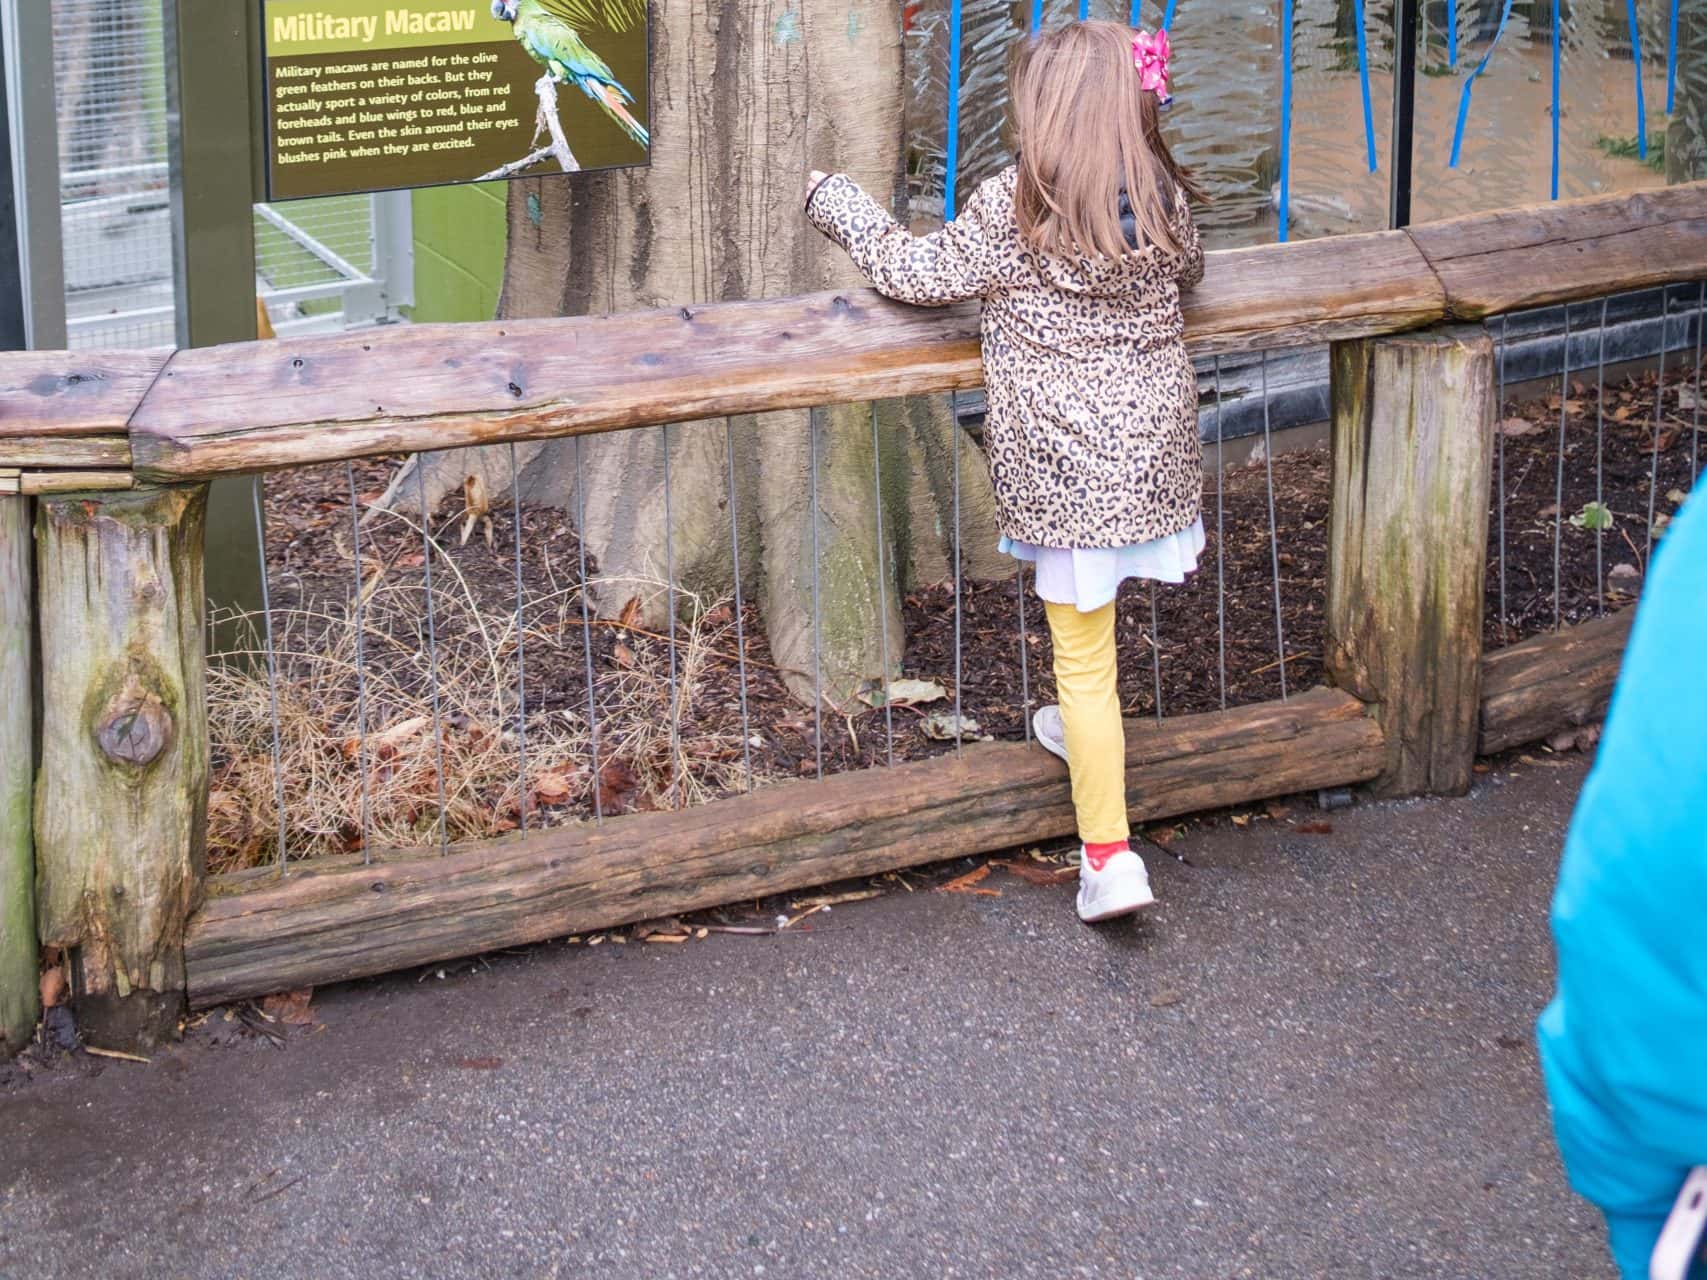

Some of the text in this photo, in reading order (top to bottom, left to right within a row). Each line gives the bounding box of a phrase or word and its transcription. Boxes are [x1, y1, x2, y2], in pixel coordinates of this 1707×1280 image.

[274, 9, 475, 42] Military Macaw
[276, 52, 498, 78] Military macaws are named for the olive
[276, 70, 493, 98] green feathers on their backs. But they
[276, 83, 510, 112] actually sport a variety of colors, from red
[277, 100, 506, 130] foreheads and blue wings to red, blue and
[277, 118, 519, 147] brown tails. Even the skin around their eyes
[278, 136, 475, 164] blushes pink when they are excited.
